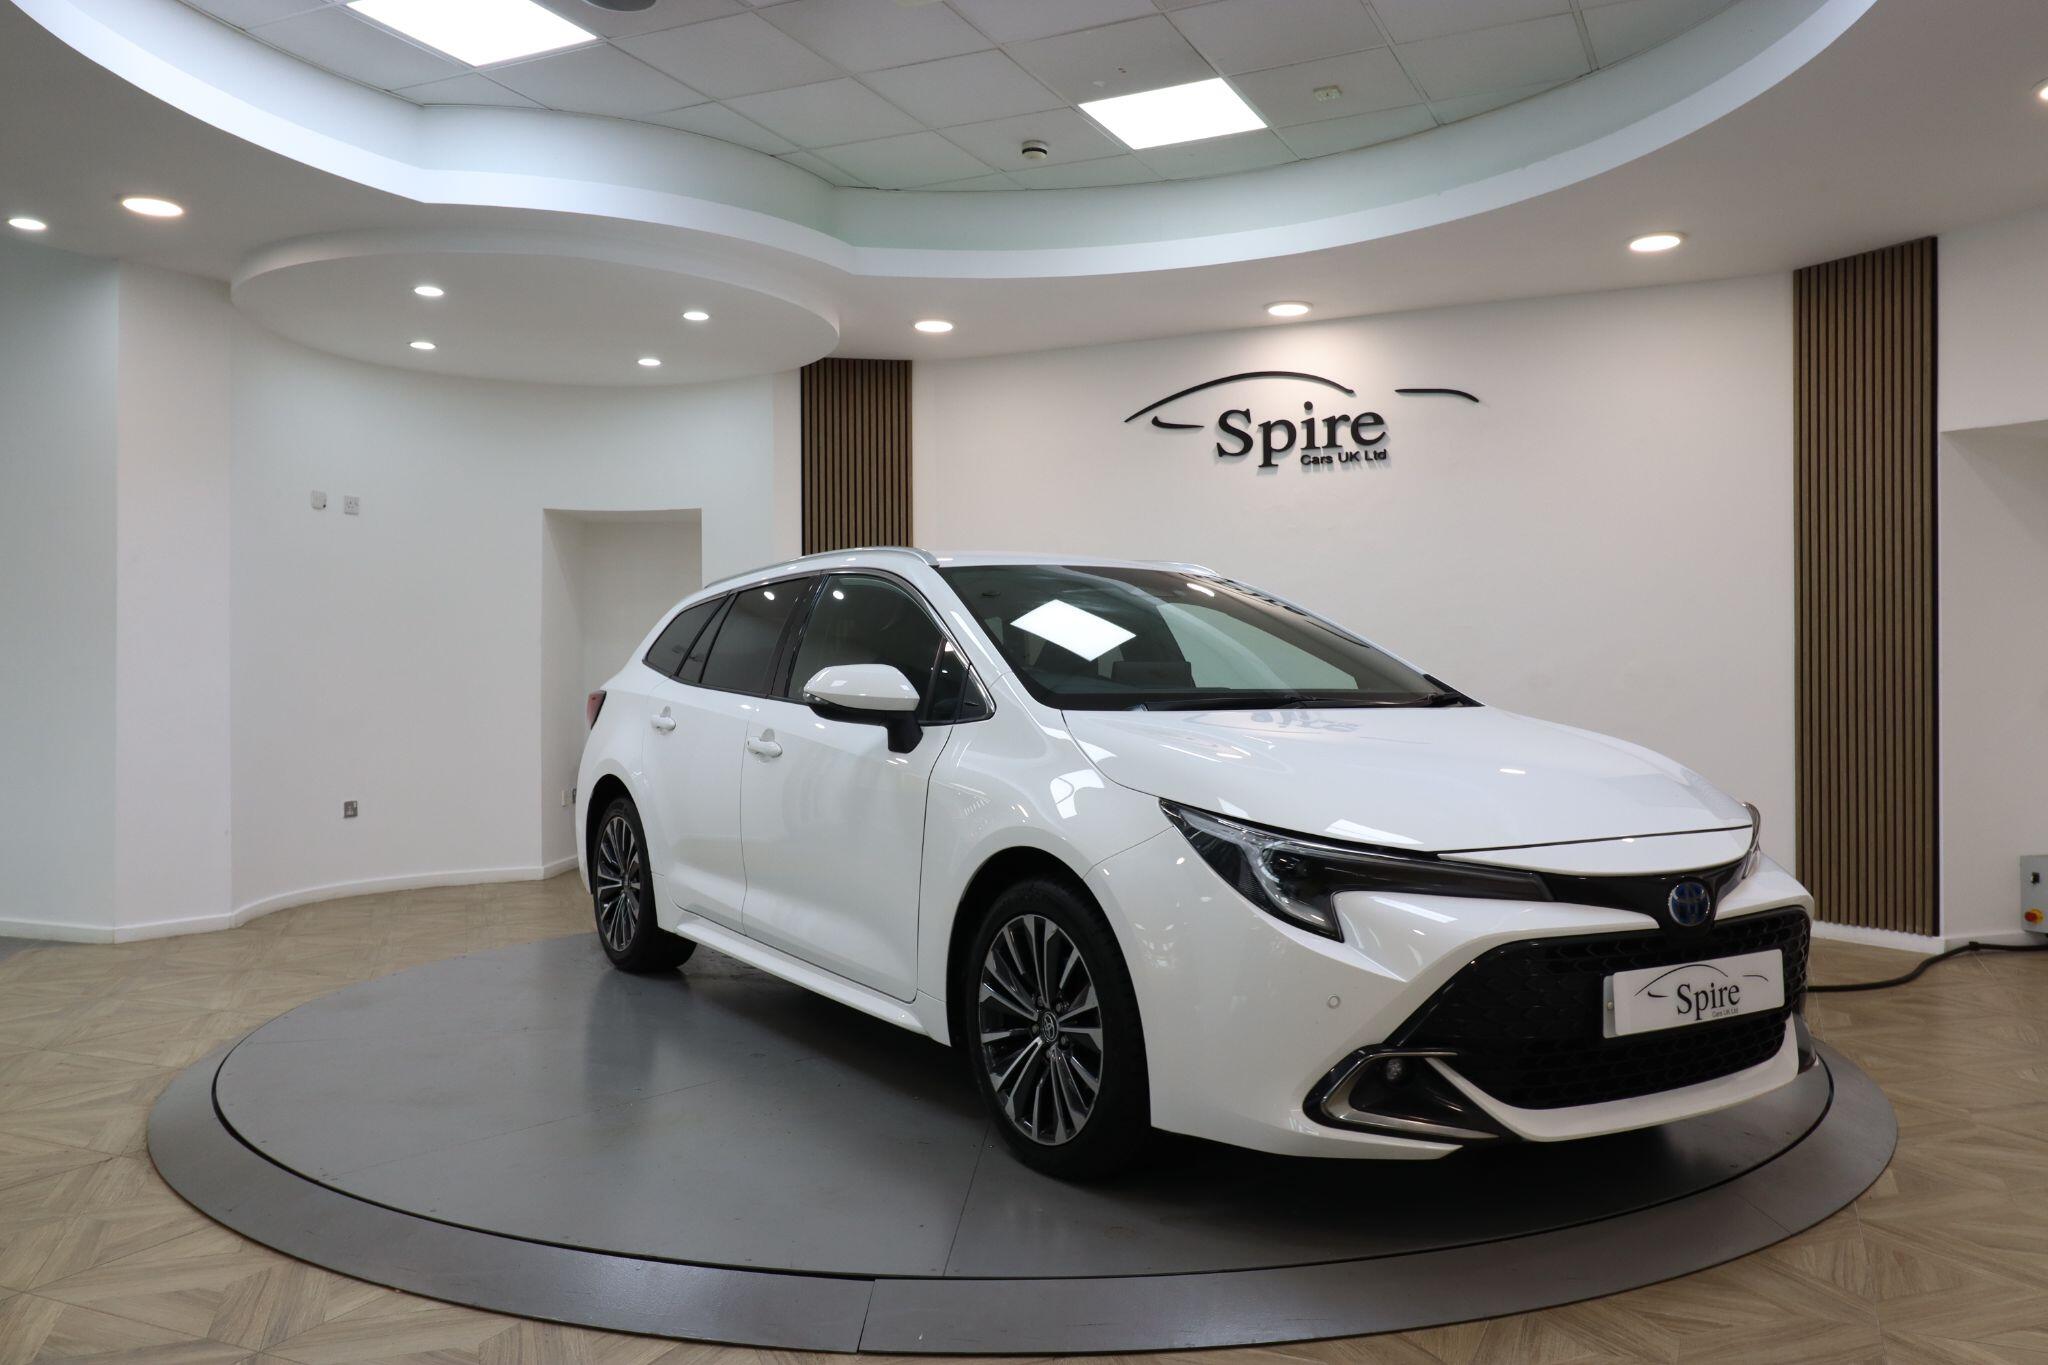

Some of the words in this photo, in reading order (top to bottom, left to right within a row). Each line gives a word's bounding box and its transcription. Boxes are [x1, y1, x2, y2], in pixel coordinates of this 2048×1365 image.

[1216, 401, 1386, 468] Spire
[1300, 454, 1334, 466] Cars
[1337, 450, 1361, 463] UK
[1364, 448, 1387, 462] Ltd
[1677, 982, 1740, 1021] Spire
